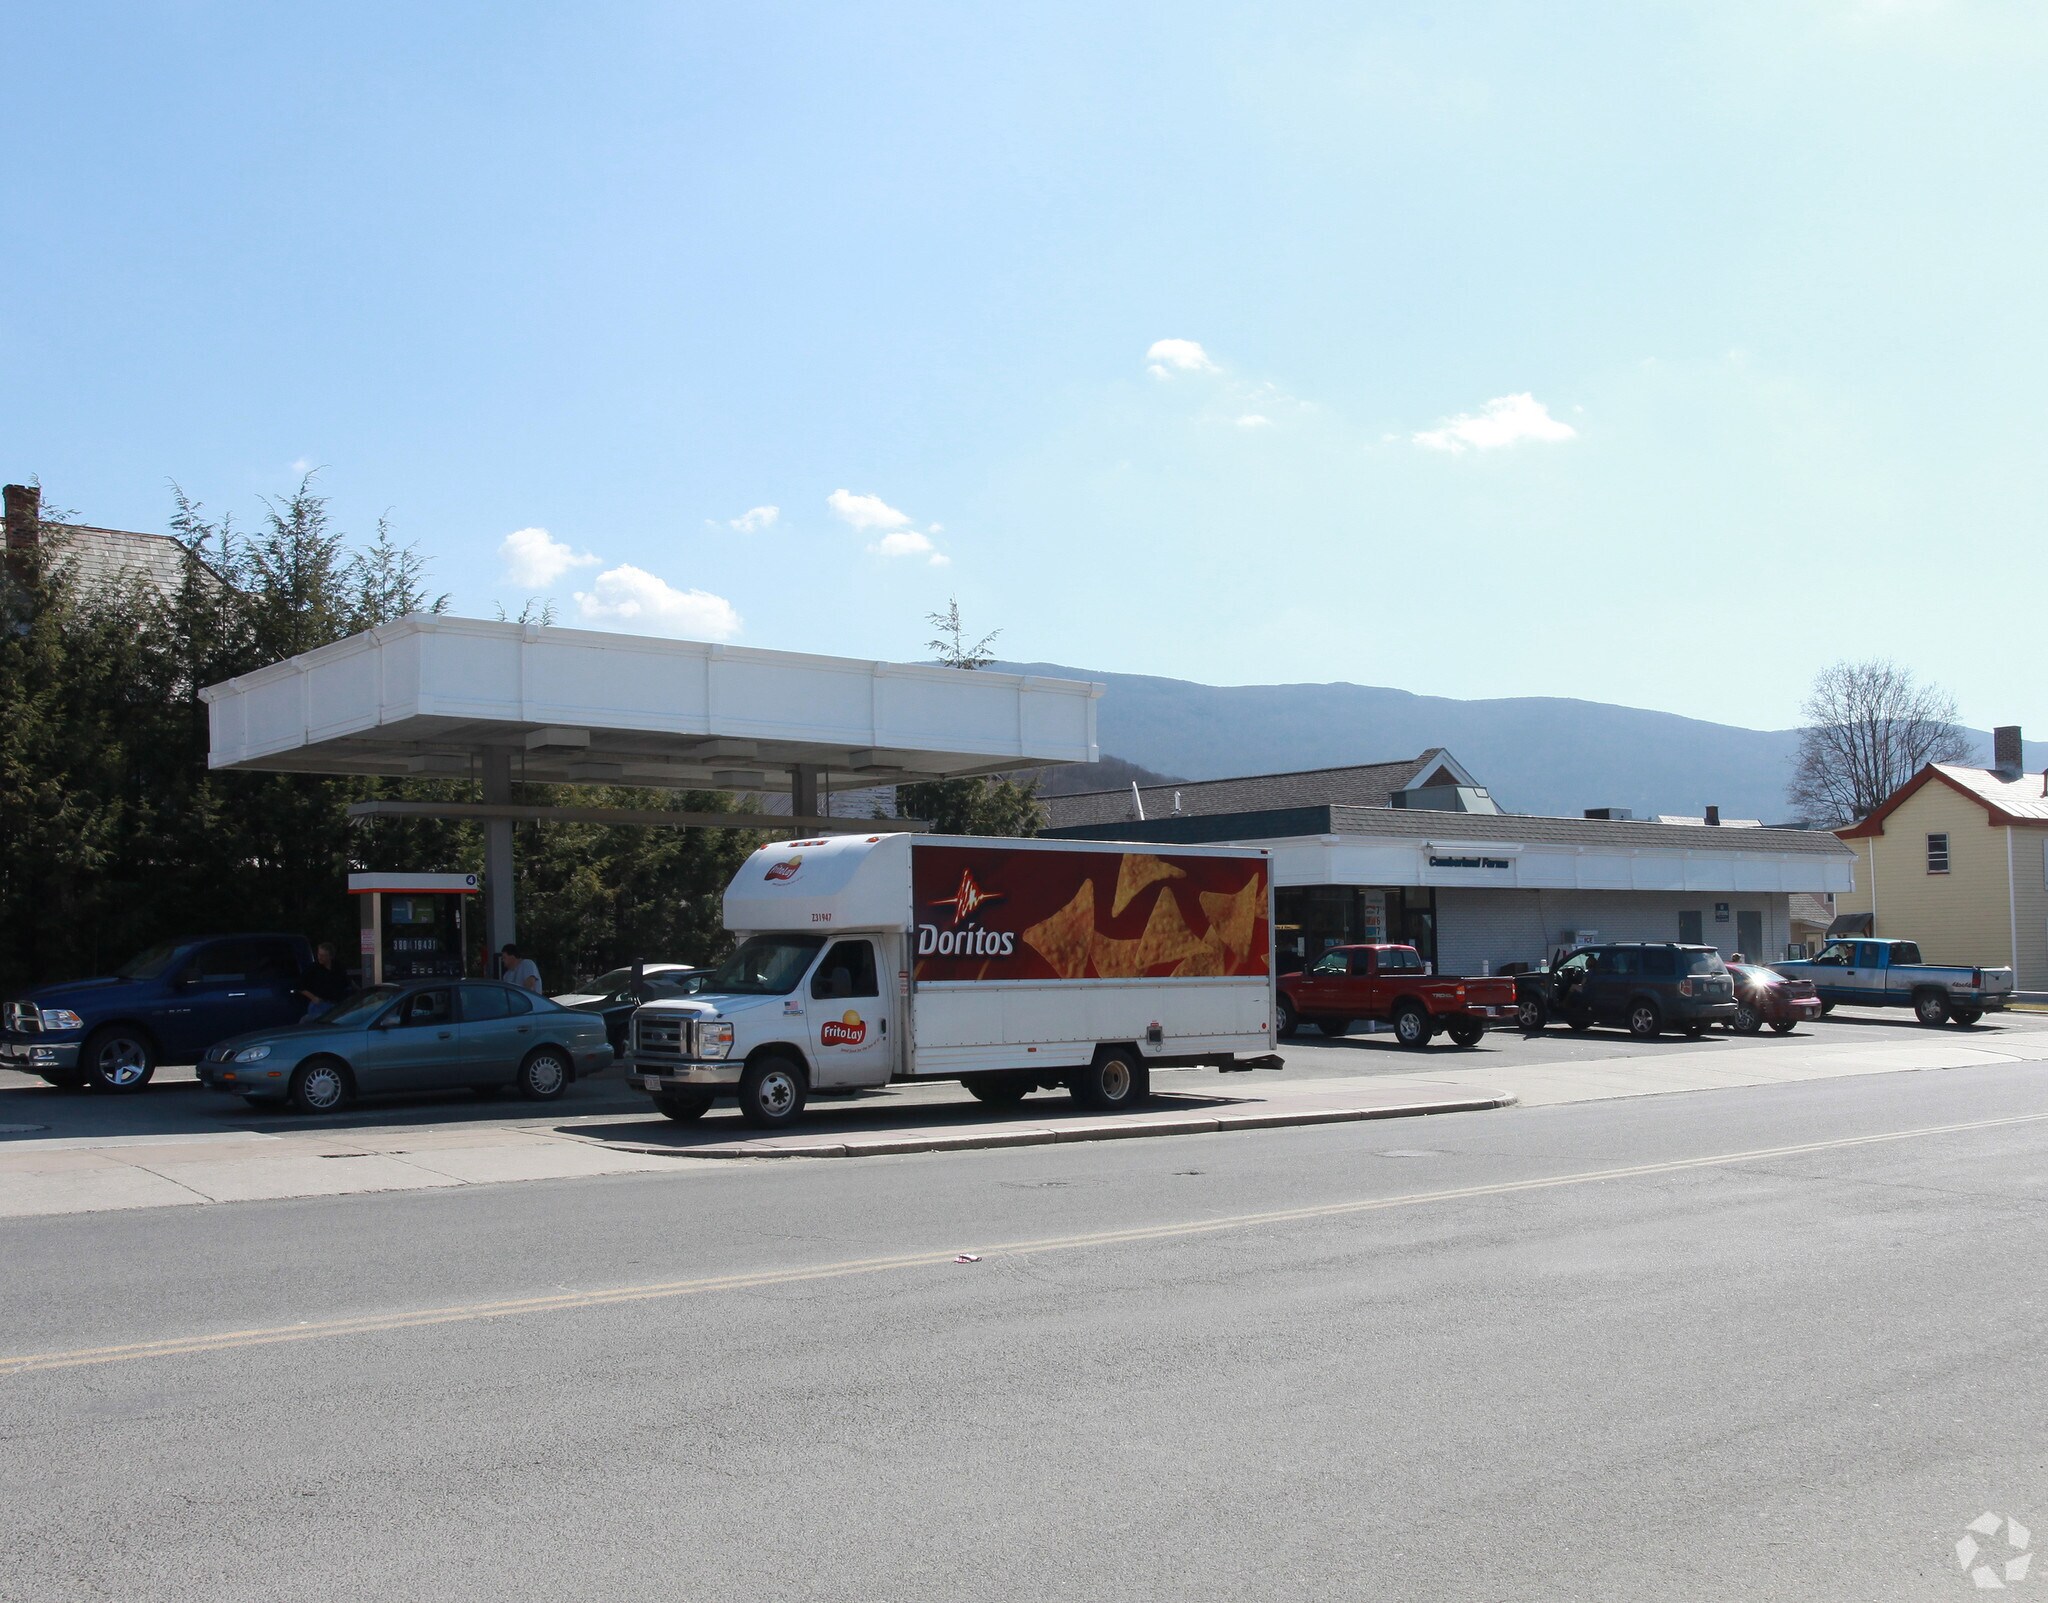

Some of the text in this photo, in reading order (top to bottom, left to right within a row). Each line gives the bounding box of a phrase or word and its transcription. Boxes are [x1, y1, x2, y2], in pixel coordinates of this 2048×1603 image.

[467, 875, 474, 884] 4
[811, 913, 832, 922] Z31947
[918, 922, 1015, 955] Doritos
